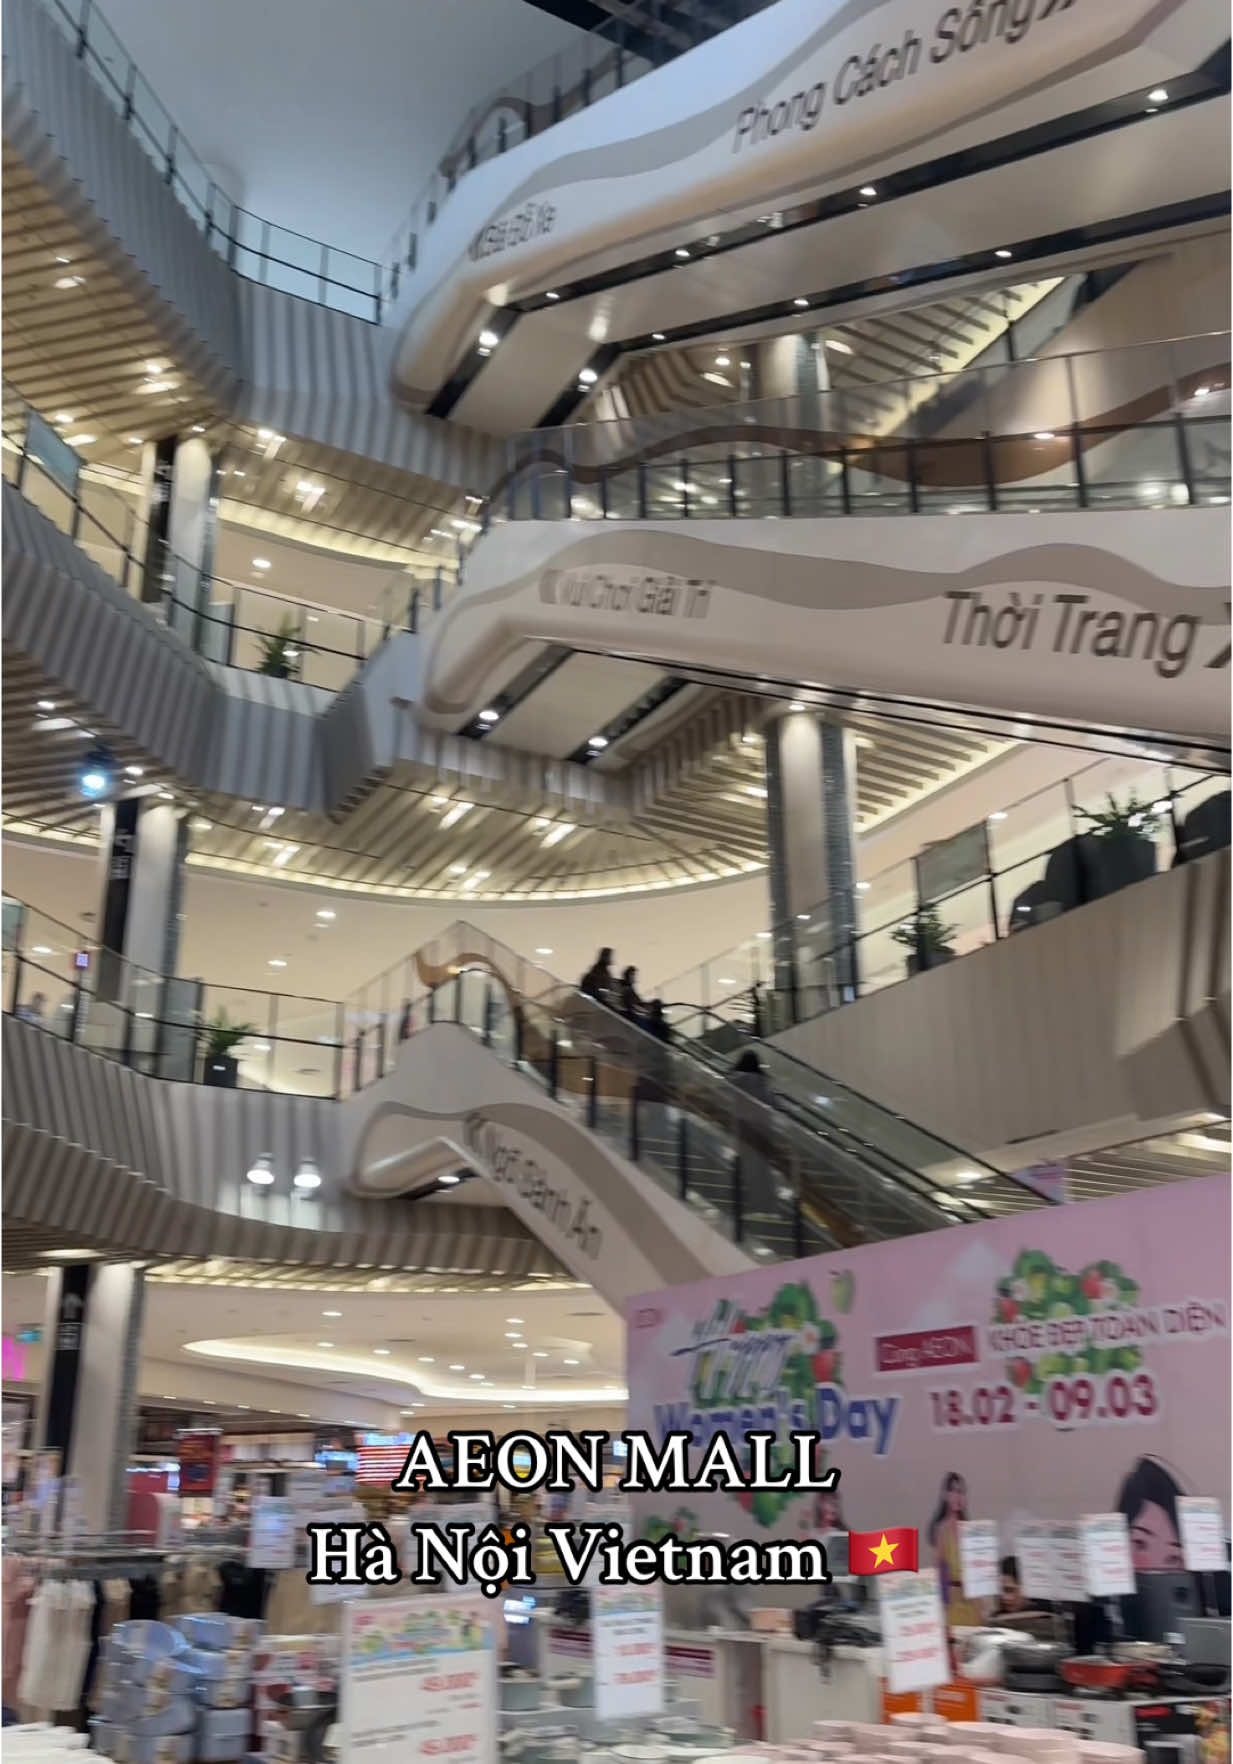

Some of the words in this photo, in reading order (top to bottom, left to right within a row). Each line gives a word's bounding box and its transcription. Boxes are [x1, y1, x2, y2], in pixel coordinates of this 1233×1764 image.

[732, 82, 826, 154] Phong
[833, 29, 922, 105] Cách
[943, 591, 1044, 650] Thời
[1052, 594, 1203, 679] Trang
[815, 1387, 900, 1456] Day
[931, 1385, 1016, 1428] 18.02
[1048, 1373, 1158, 1422] 09.03
